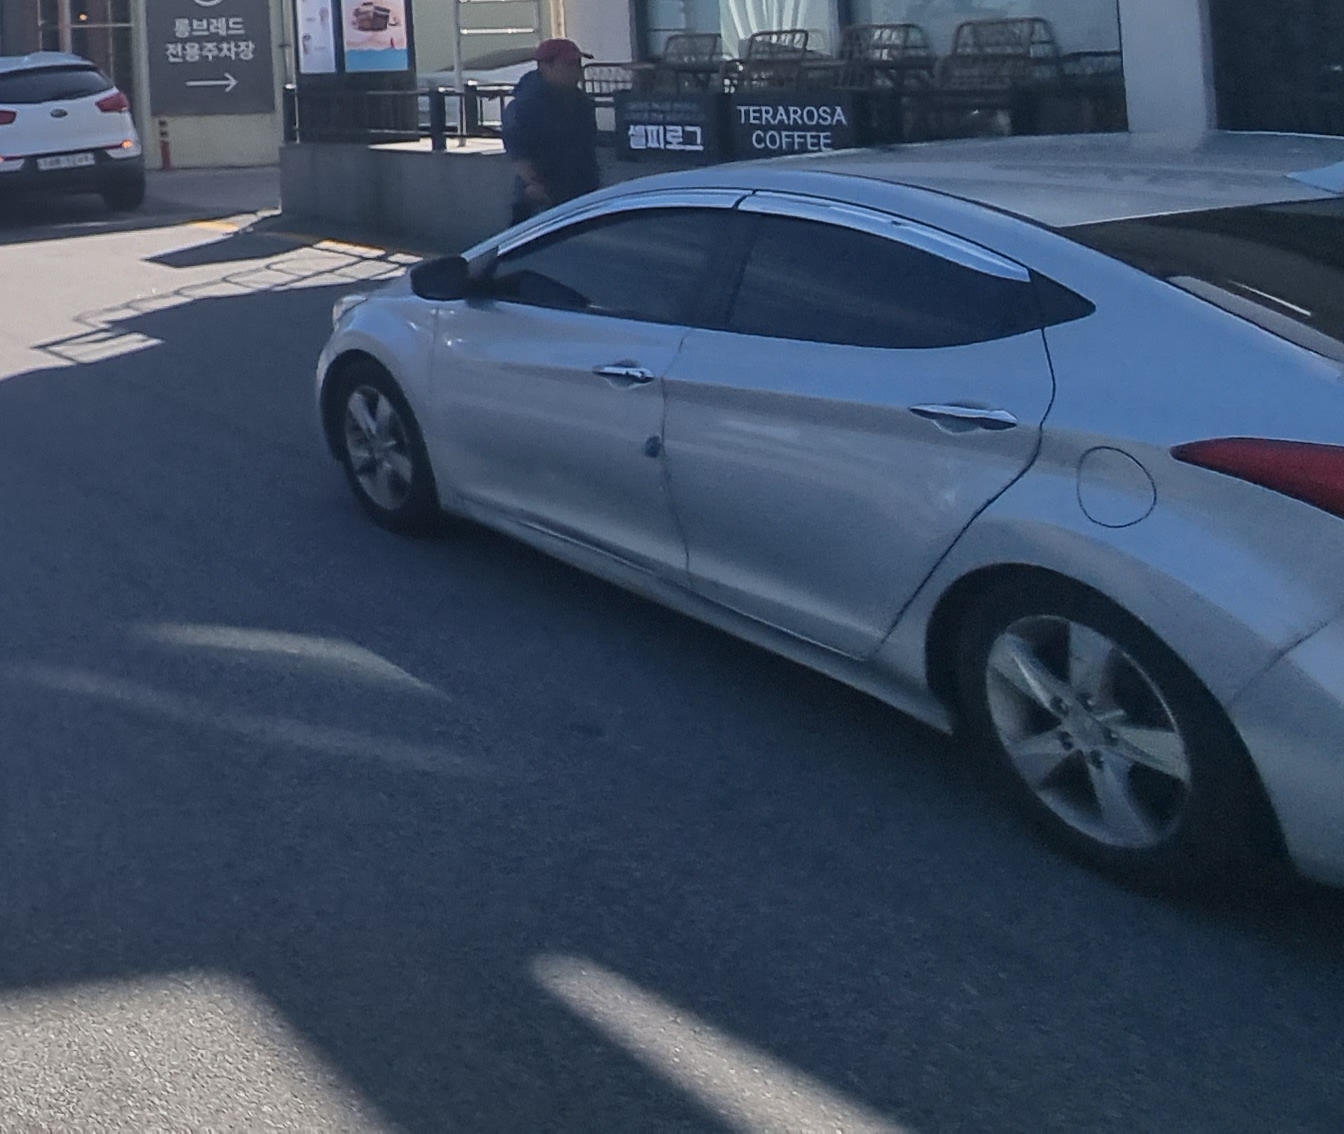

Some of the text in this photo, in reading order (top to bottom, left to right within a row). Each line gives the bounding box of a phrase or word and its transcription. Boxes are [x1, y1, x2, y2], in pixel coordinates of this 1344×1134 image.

[165, 40, 255, 63] 전용주차장
[736, 105, 847, 126] TERAROSA
[752, 130, 833, 151] COFFEE
